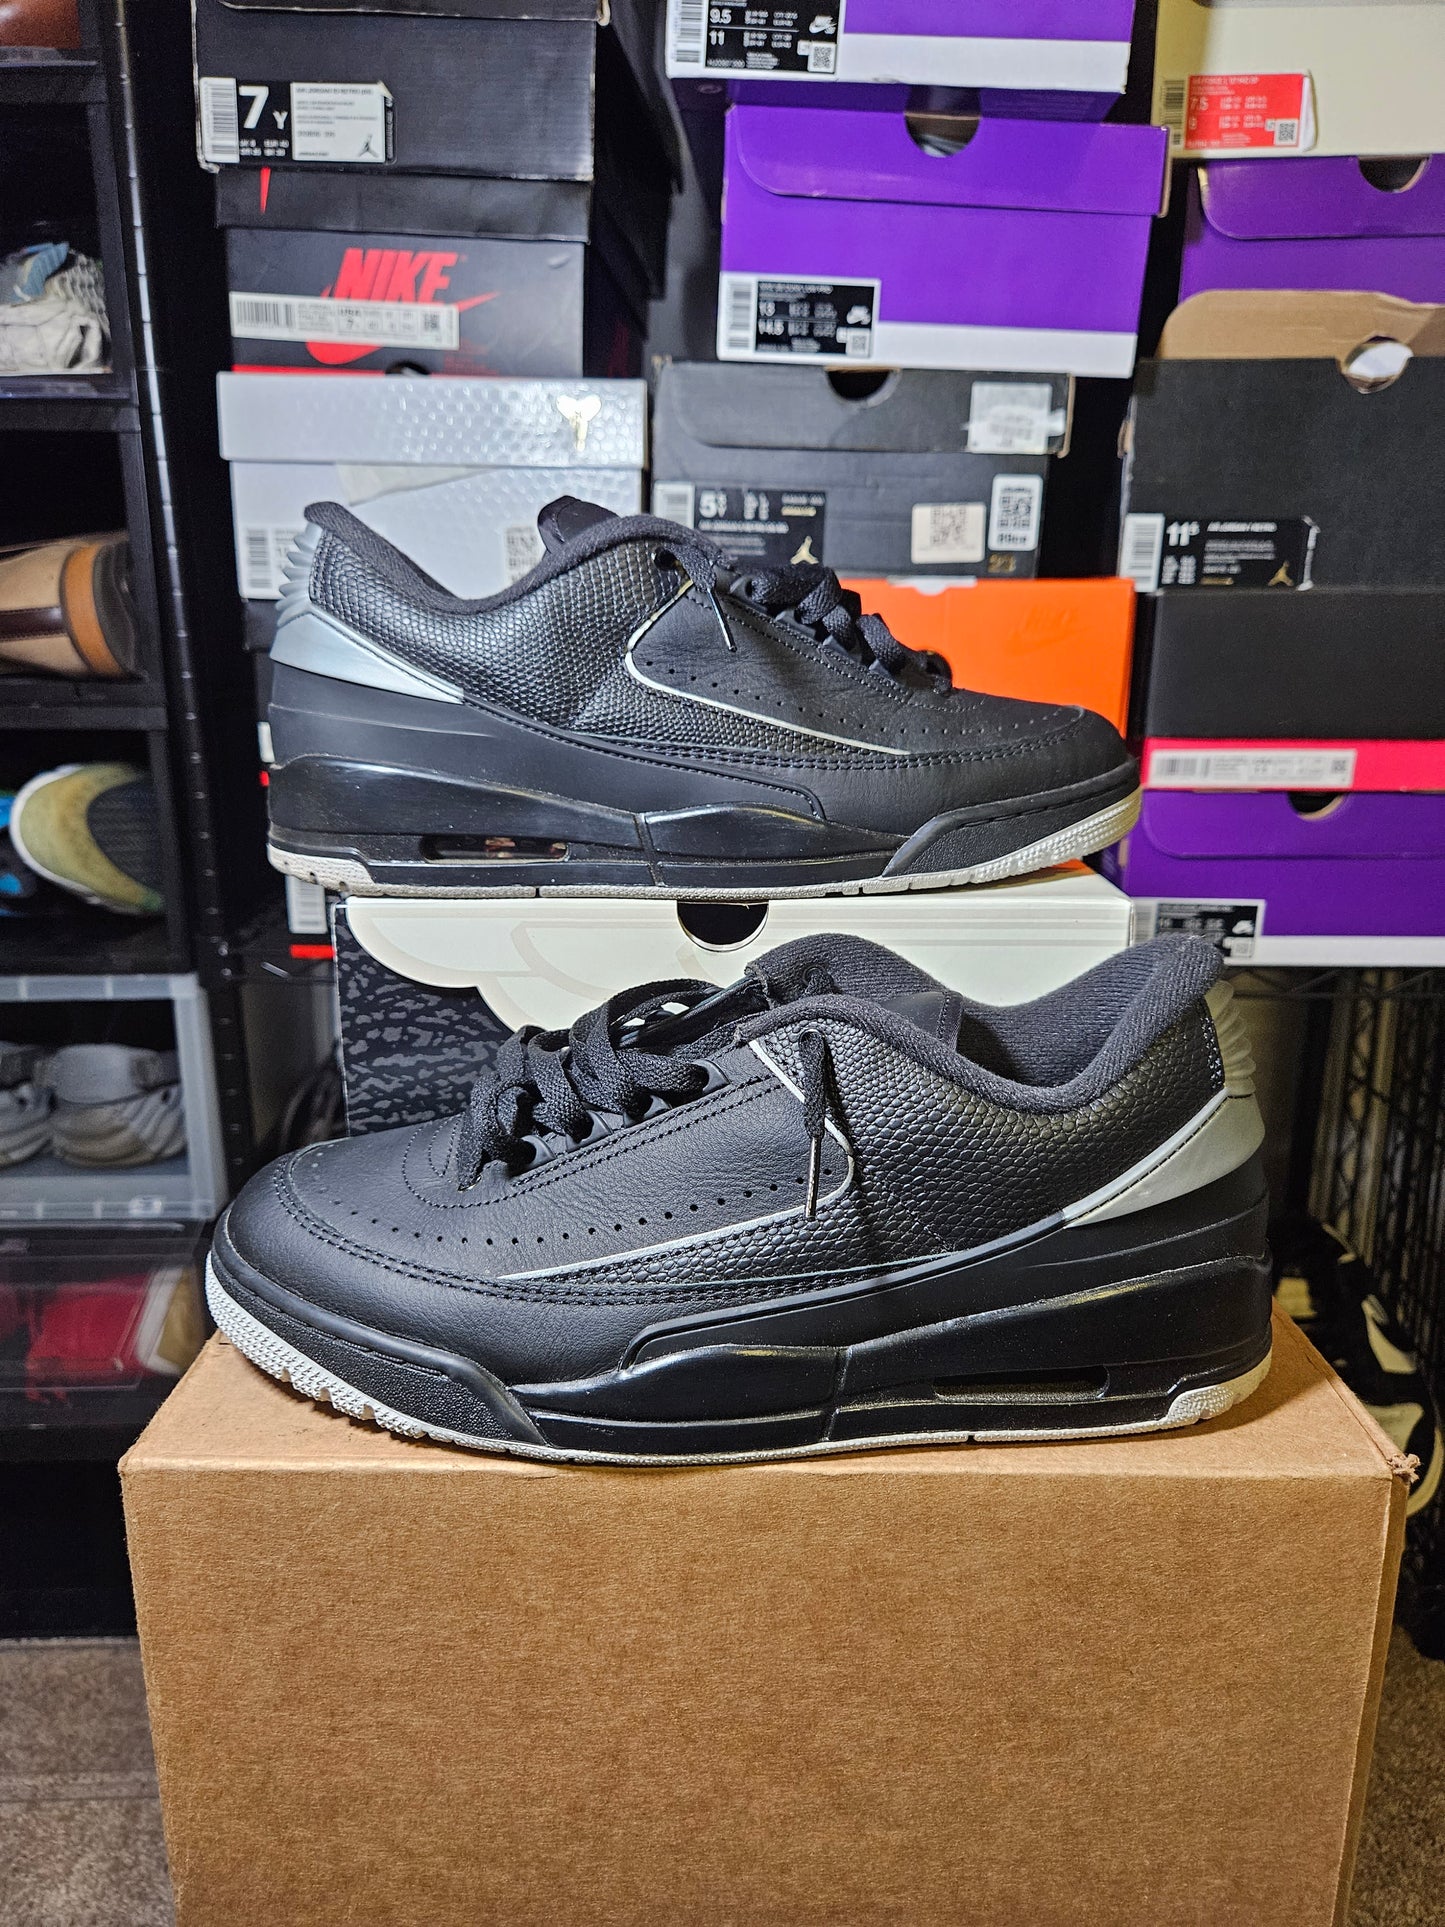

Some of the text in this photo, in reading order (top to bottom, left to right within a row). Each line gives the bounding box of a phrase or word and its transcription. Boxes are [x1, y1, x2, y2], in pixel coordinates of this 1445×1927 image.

[709, 8, 732, 24] 9.5
[709, 29, 725, 46] 11
[239, 85, 288, 130] 7 Y
[333, 247, 458, 305] NIKE
